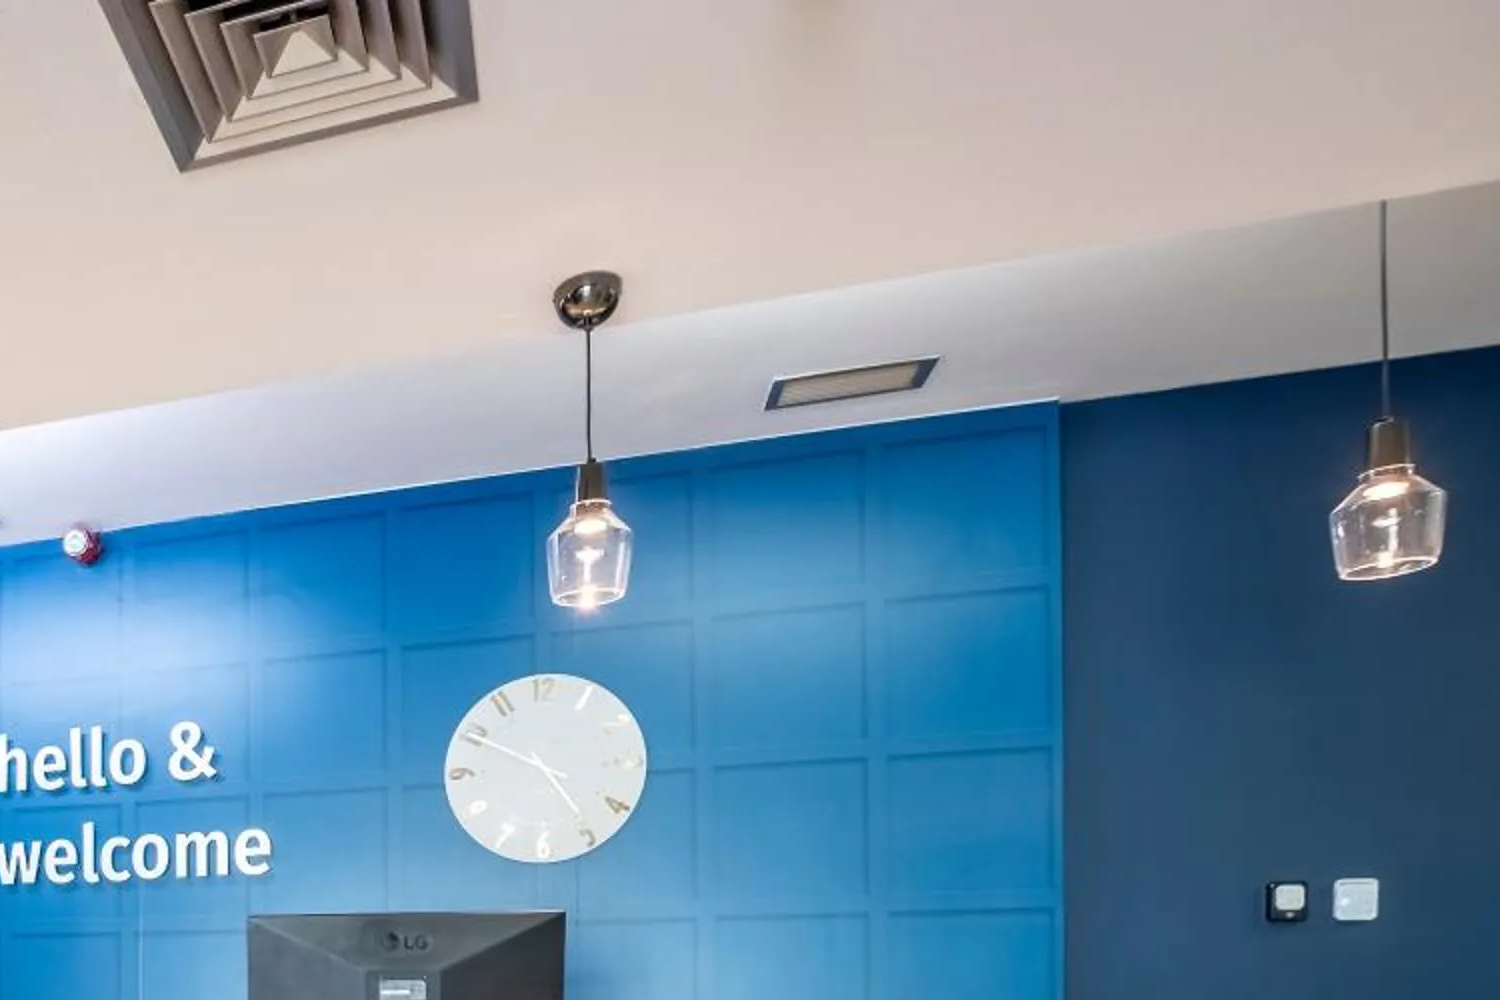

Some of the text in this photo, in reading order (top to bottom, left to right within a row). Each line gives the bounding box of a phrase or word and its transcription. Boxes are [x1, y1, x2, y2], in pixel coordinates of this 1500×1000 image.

[533, 678, 556, 703] 12
[490, 691, 515, 717] 11
[168, 721, 217, 782] &
[450, 767, 475, 781] 9
[604, 796, 631, 814] 4
[404, 935, 428, 950] LG
